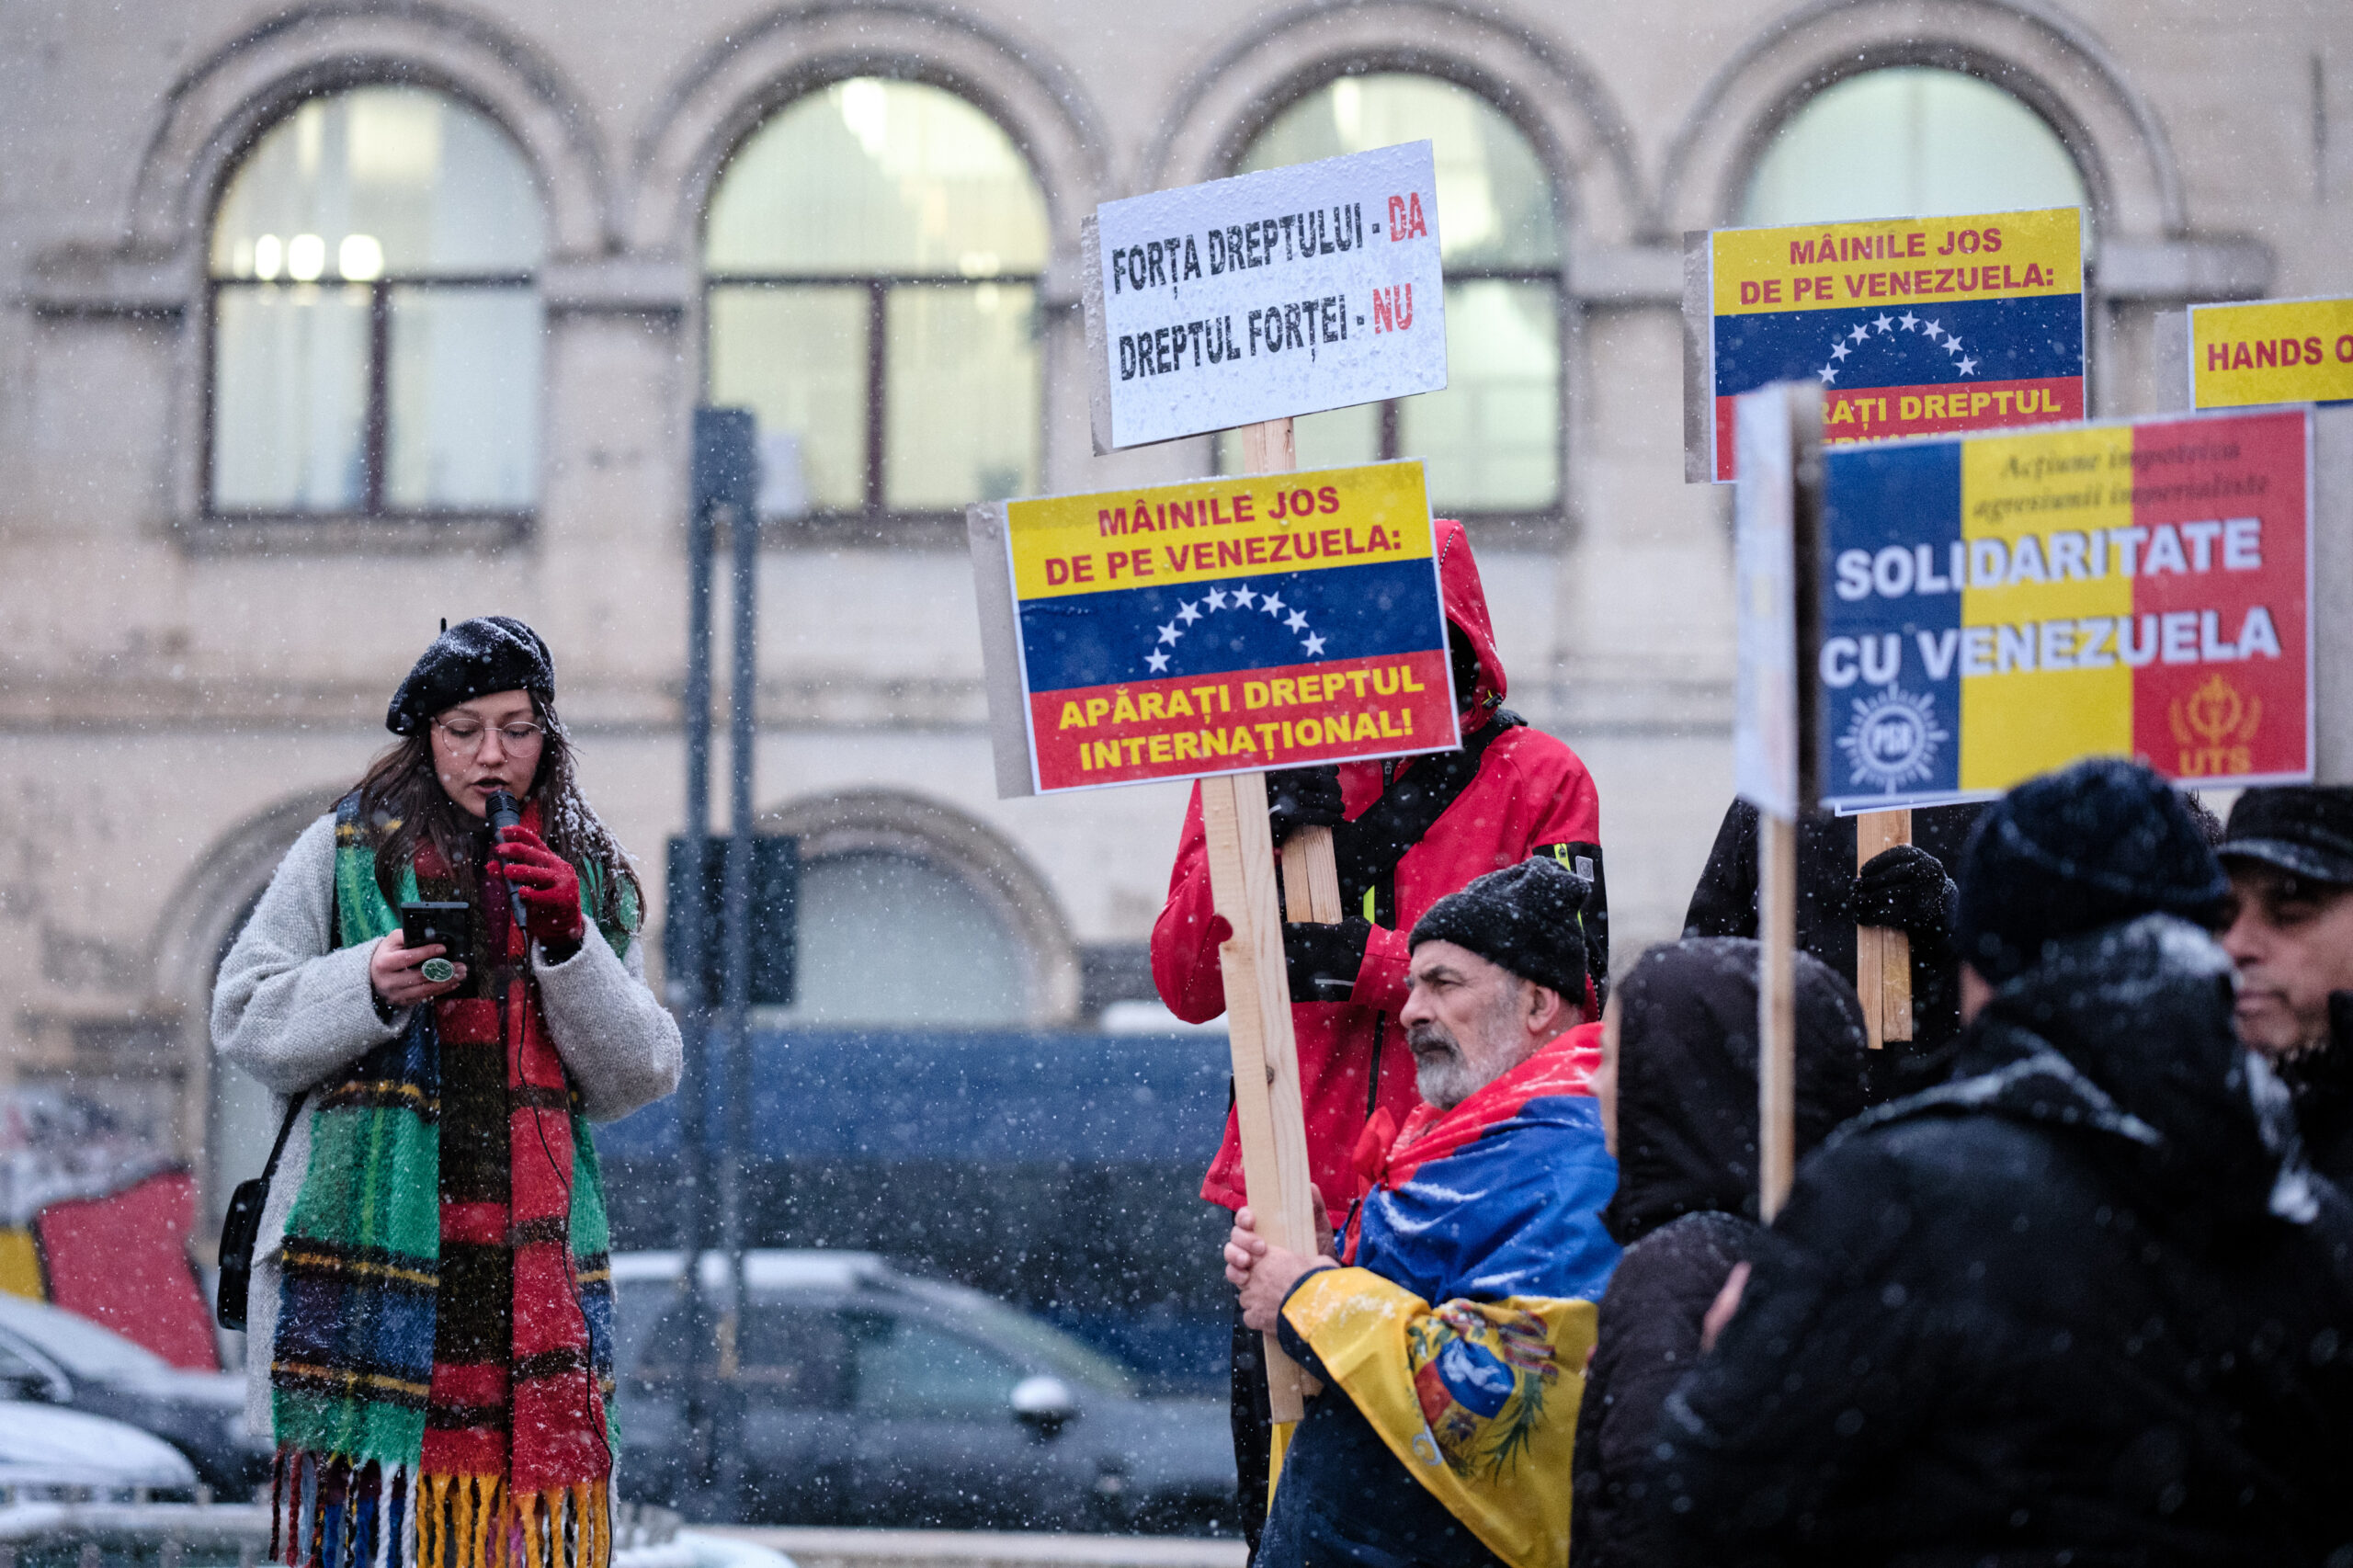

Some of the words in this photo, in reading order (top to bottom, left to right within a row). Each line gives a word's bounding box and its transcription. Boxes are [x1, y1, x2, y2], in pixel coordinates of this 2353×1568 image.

[1208, 203, 1363, 276] DREPTULUI
[1388, 192, 1427, 242] DA
[1790, 233, 1927, 266] MÂINILE
[1938, 228, 2002, 256] JOS
[1740, 279, 1782, 305] DE
[1793, 277, 1834, 301] PE
[1844, 263, 2054, 299] VENEZUELA:
[1120, 315, 1241, 381] DREPTUL
[1372, 283, 1414, 335] NU
[2207, 336, 2324, 371] HANDS
[1900, 388, 2062, 421] DREPTUL
[1097, 494, 1256, 538] MÂINILE
[1267, 485, 1340, 520] JOS
[1045, 553, 1095, 586] DE
[1107, 547, 1154, 580] PE
[1165, 524, 1403, 574] VENEZUELA:
[1836, 517, 2263, 601] SOLIDARITATE
[1819, 632, 1902, 688] CU
[1916, 606, 2281, 681] VENEZUELA
[1058, 683, 1231, 731] APĂRAȚI
[1244, 665, 1426, 711] DREPTUL
[1079, 708, 1414, 771] INTERNAȚIONAL!
